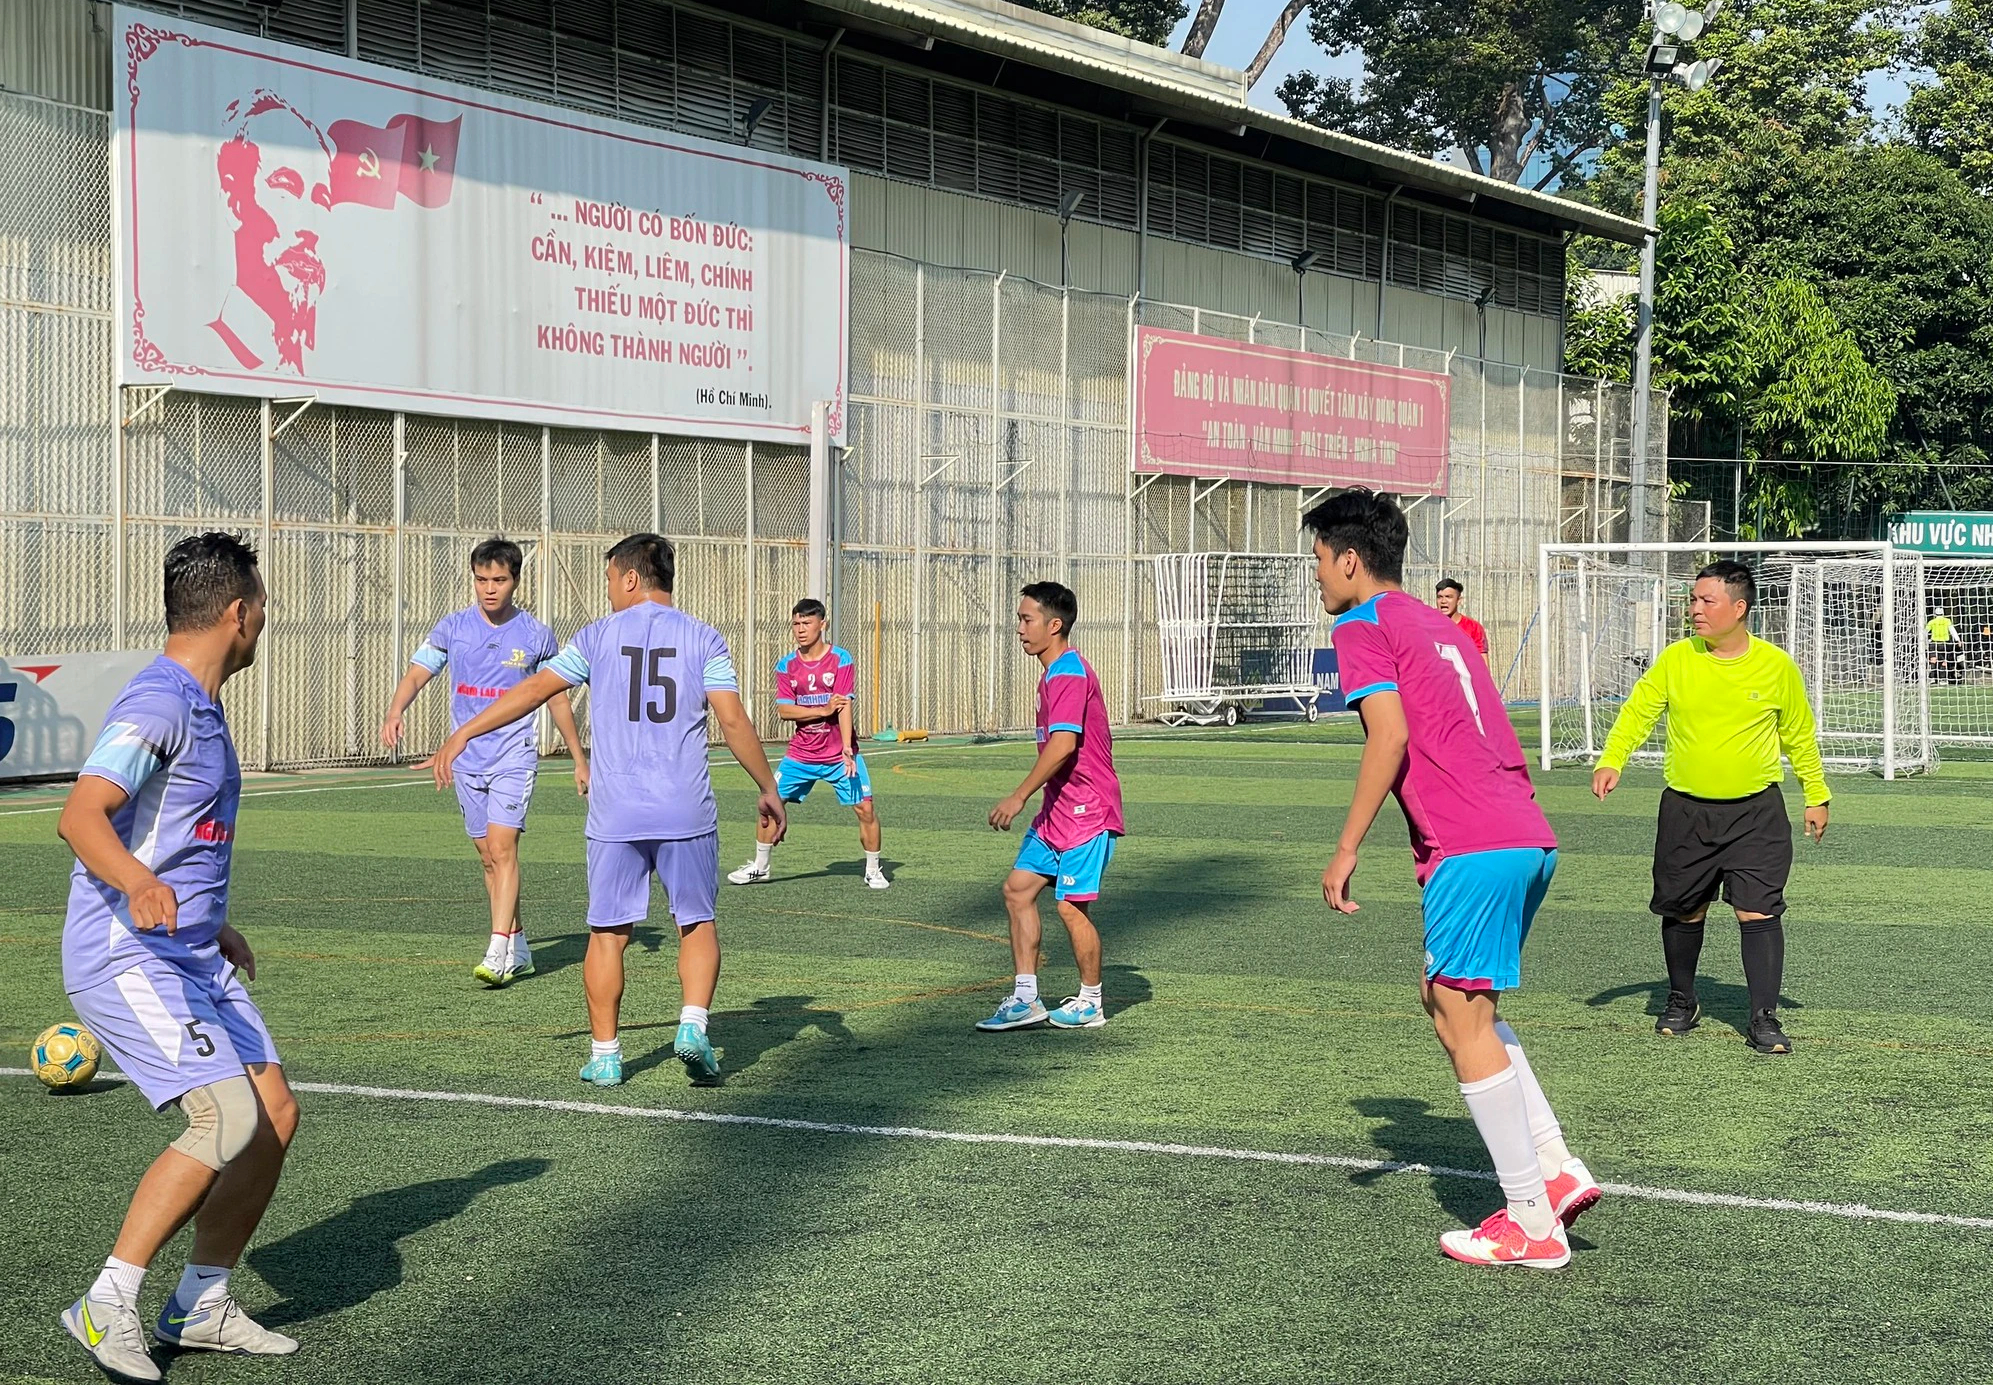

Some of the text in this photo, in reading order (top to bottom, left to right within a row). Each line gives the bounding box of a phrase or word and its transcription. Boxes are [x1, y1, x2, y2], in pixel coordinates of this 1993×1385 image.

[575, 200, 632, 233] NGƯỜI
[638, 209, 663, 238] CÓ
[670, 212, 707, 245] BỐN
[712, 221, 753, 252] ĐỨC:
[531, 228, 753, 292] CẦN, KIỆM, LIÊM, CHÍNH
[575, 283, 753, 332] THIẾU MỘT ĐỨC THÌ
[537, 322, 604, 356] KHÔNG
[610, 331, 672, 363] THÀNH
[679, 341, 731, 369] NGƯỜI
[696, 387, 772, 410] (Hồ Chí Minh).
[1174, 362, 1200, 399] ĐẢNG
[1202, 368, 1214, 408] BỘ
[1218, 370, 1230, 403] VÀ
[1233, 373, 1257, 406] NHÂN
[1258, 376, 1276, 409] DÂN
[1278, 380, 1300, 417] QUẬN
[1302, 387, 1307, 412] 1
[1309, 382, 1335, 418] QUYẾT
[1338, 388, 1355, 419] TÂM
[1358, 391, 1374, 421] XÂY
[1397, 398, 1418, 433] QUẬN
[1420, 404, 1424, 427] 1
[1222, 417, 1246, 450] TOÀN
[1300, 426, 1322, 458] PHÁT
[1929, 519, 1967, 550] VỰC
[620, 645, 677, 724] 15
[808, 673, 817, 691] 2
[184, 1019, 216, 1057] 5
